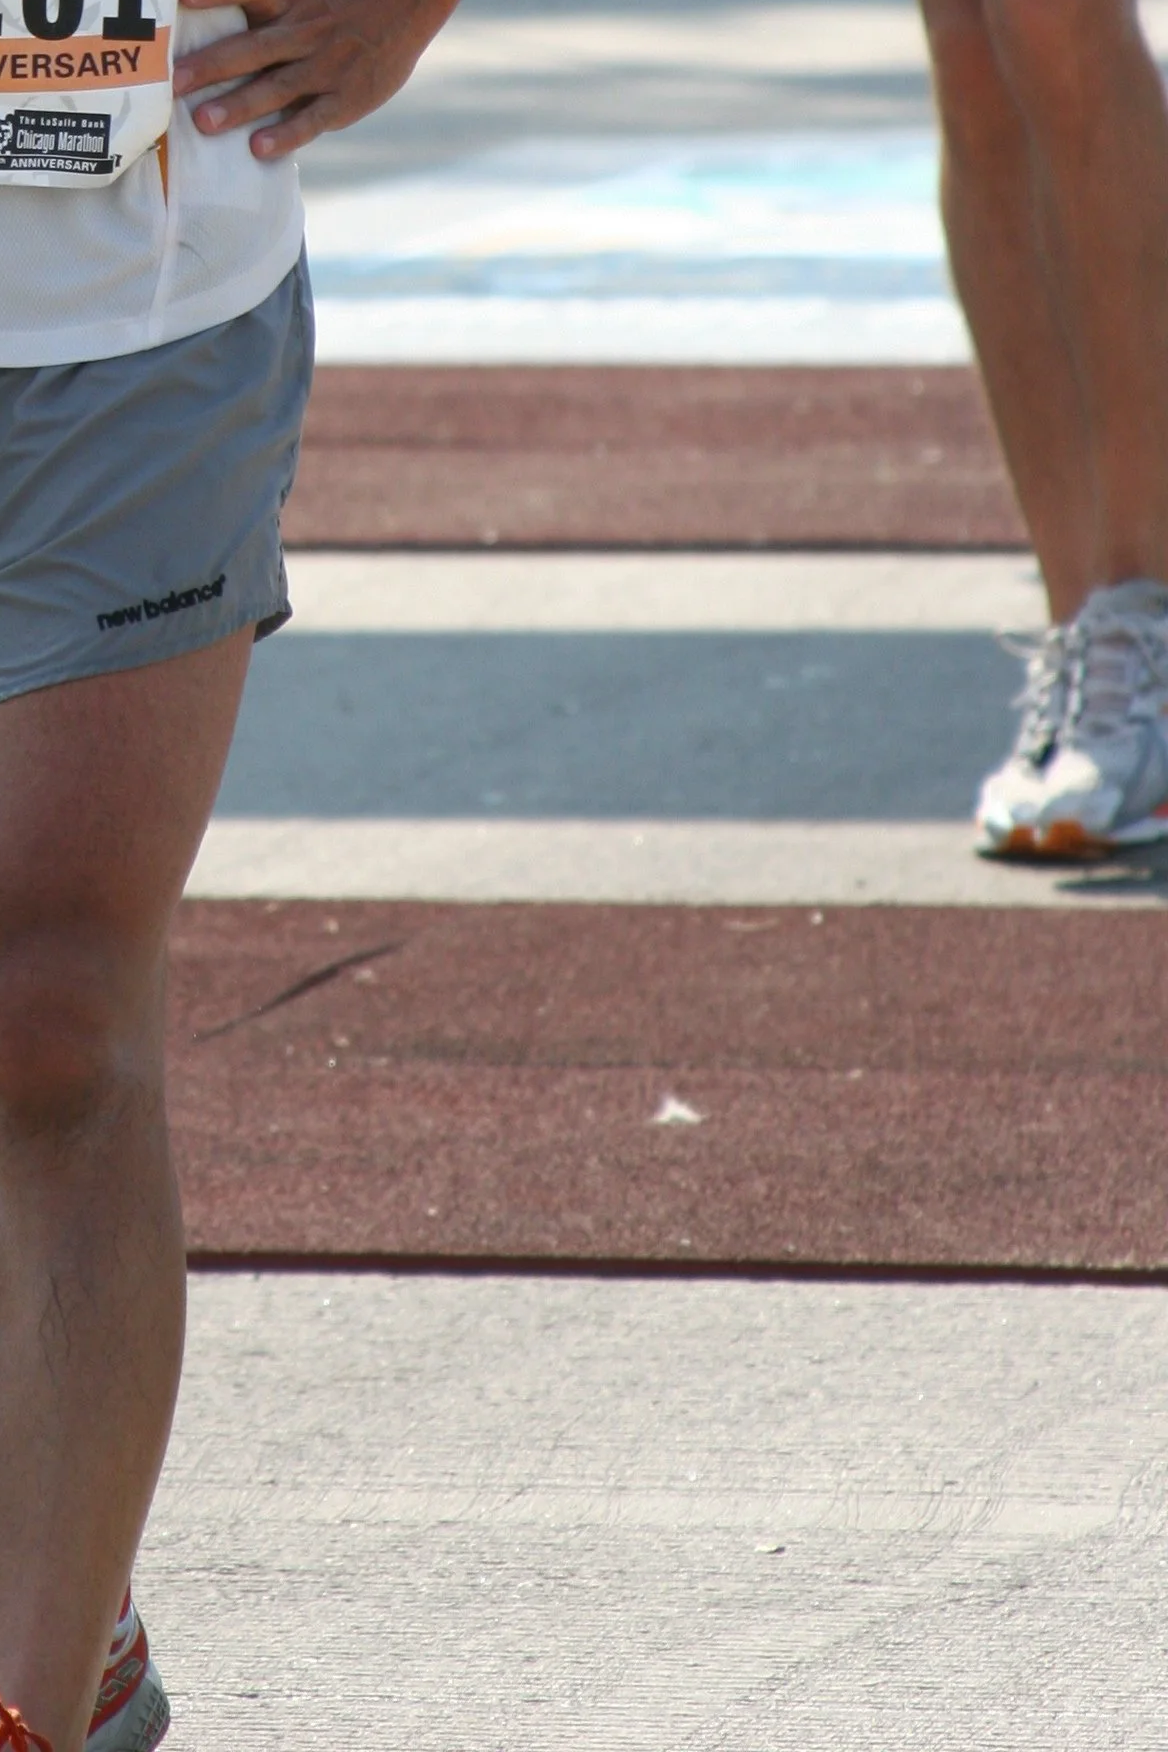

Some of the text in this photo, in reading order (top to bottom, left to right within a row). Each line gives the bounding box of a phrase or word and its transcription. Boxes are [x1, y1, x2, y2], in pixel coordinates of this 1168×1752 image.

[19, 115, 105, 129] The LaSalle Bank
[16, 129, 104, 153] Chicago Marathon
[10, 158, 98, 172] ANNIVERSARY
